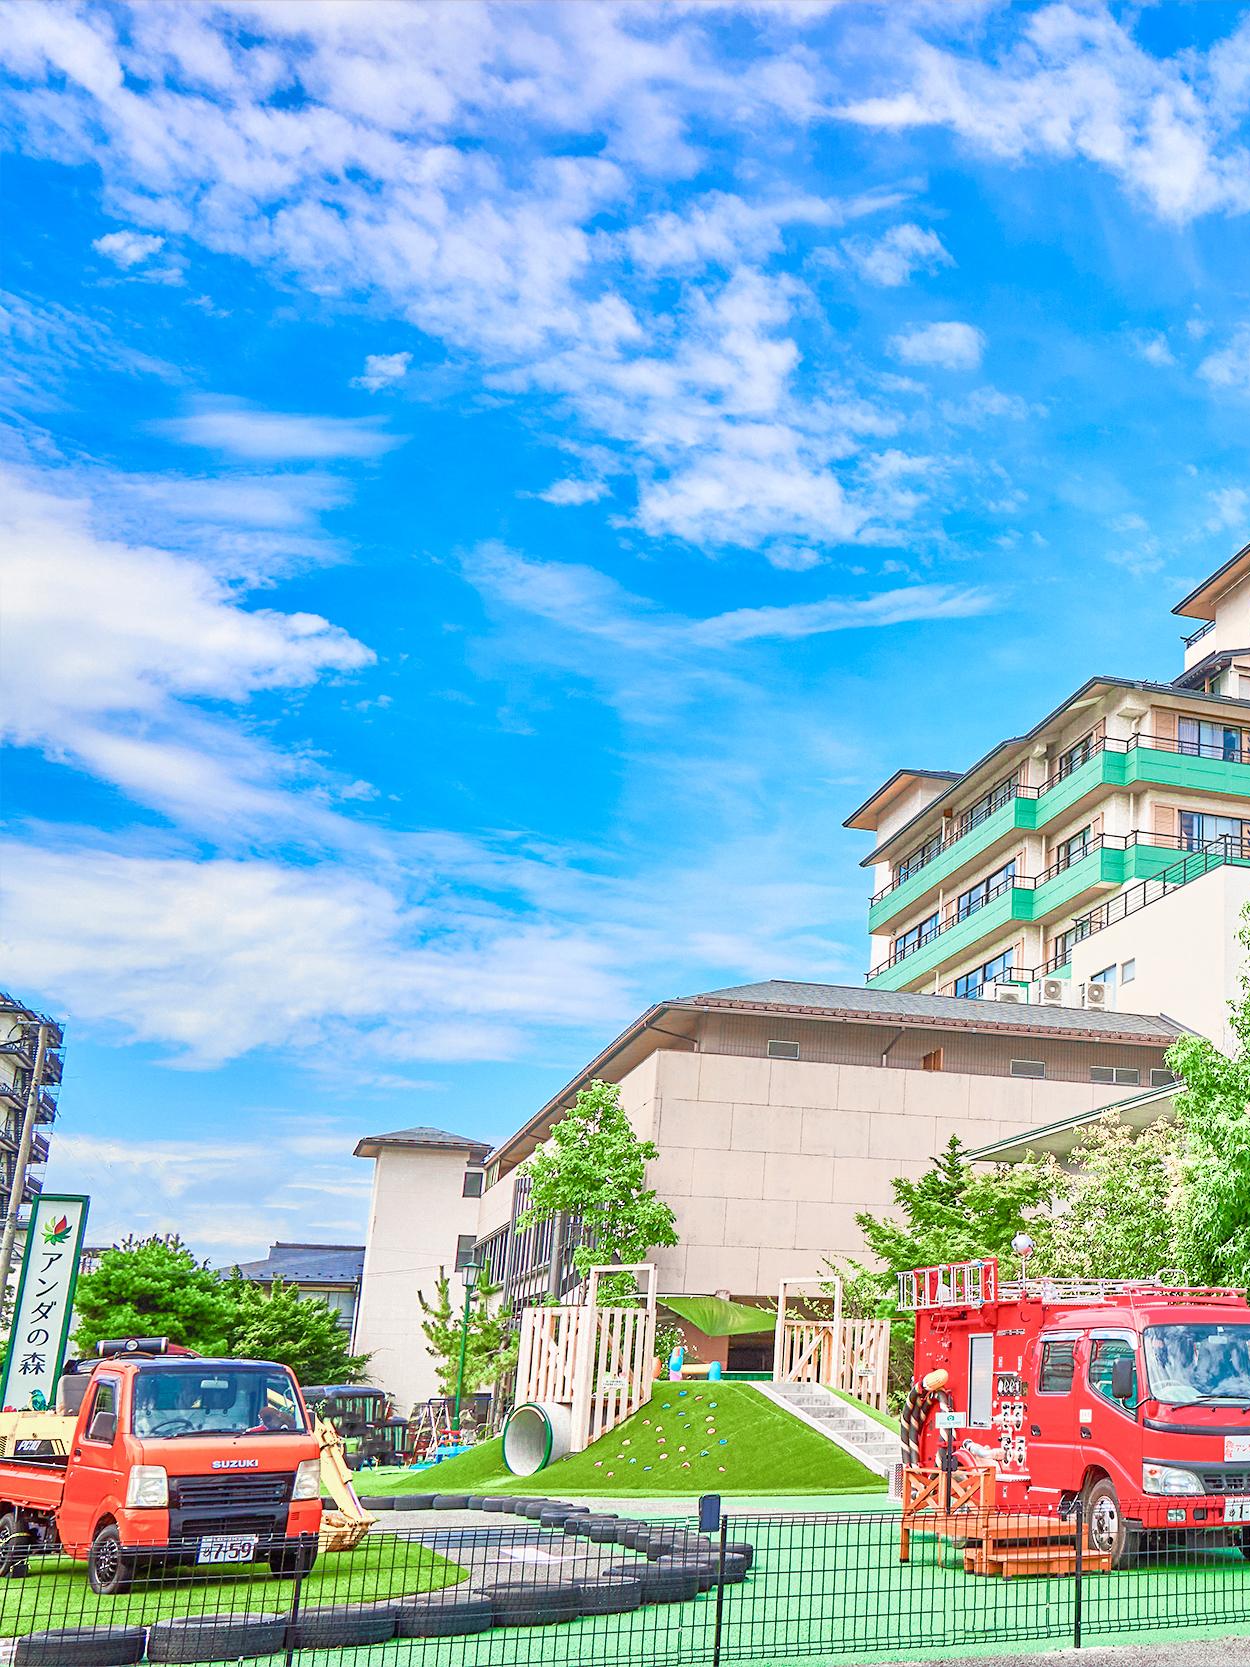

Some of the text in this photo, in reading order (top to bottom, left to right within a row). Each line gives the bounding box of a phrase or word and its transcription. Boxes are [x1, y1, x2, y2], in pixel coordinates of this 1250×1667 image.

[18, 1252, 63, 1375] アンダの森
[212, 1459, 259, 1469] SUZUKI
